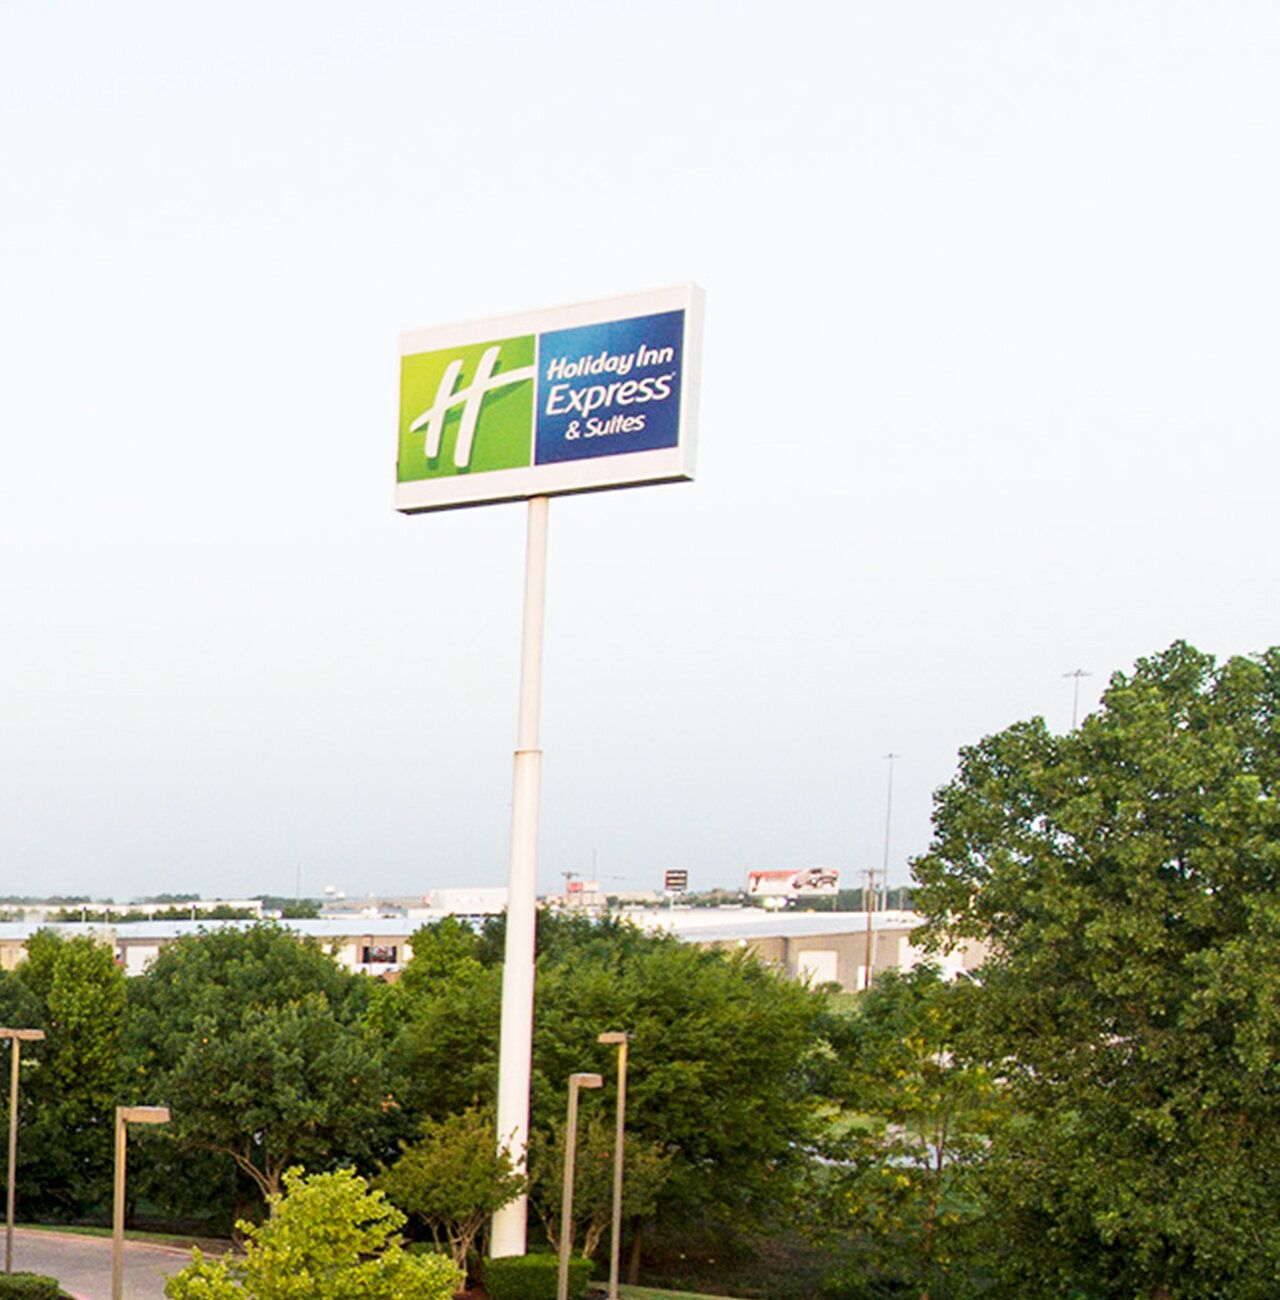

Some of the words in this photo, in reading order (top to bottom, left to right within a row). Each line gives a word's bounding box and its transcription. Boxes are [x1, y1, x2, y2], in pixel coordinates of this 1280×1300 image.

[546, 351, 635, 381] Holiday
[635, 344, 674, 367] Inn
[545, 374, 672, 418] Express
[565, 420, 581, 440] &
[584, 414, 646, 438] Suites
